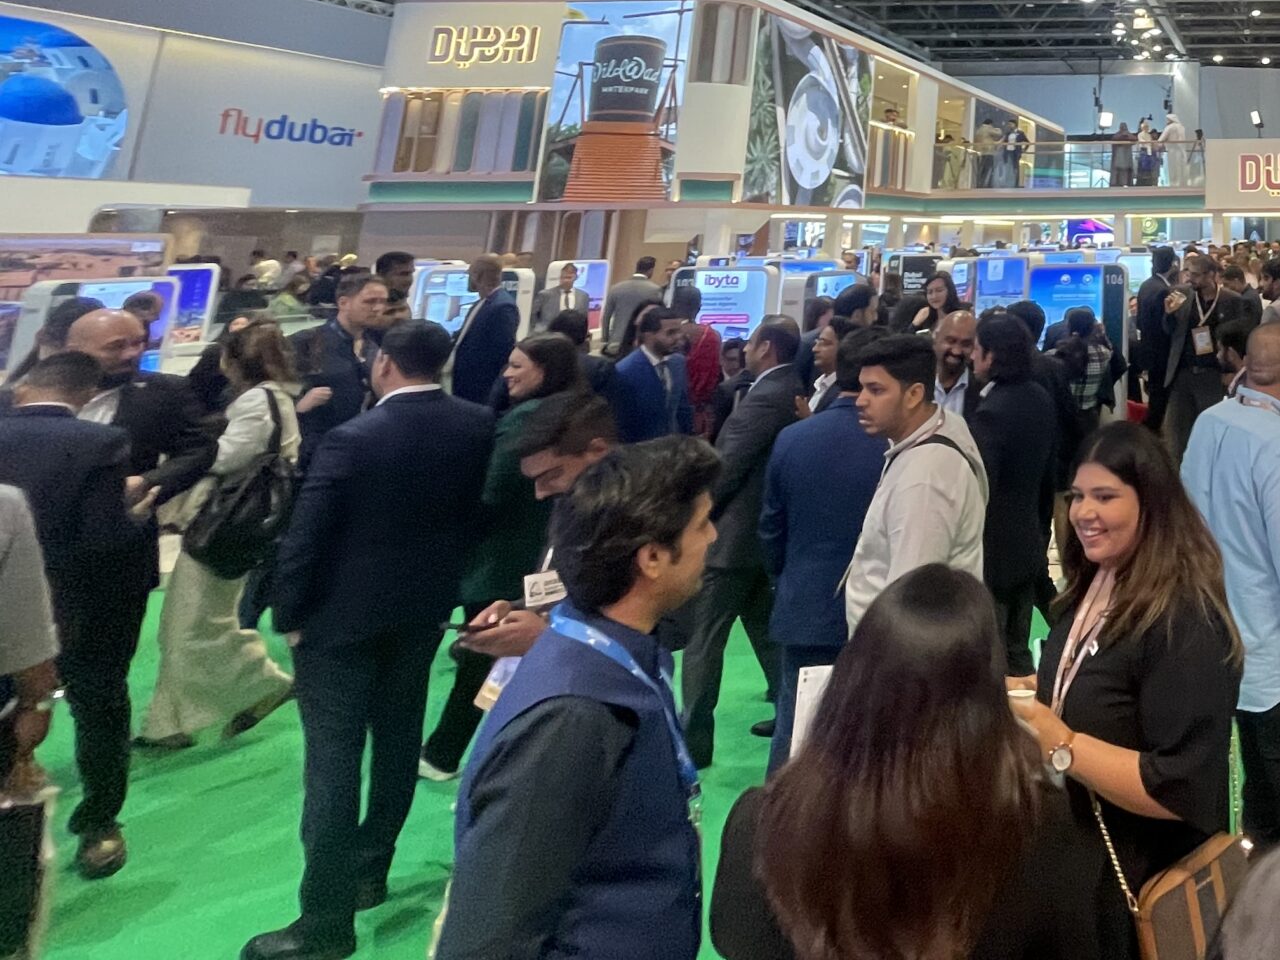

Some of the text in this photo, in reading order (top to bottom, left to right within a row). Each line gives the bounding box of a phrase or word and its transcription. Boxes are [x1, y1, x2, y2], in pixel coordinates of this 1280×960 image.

[219, 107, 363, 147] flydubai
[704, 274, 739, 289] ibyta
[1104, 274, 1123, 285] 106
